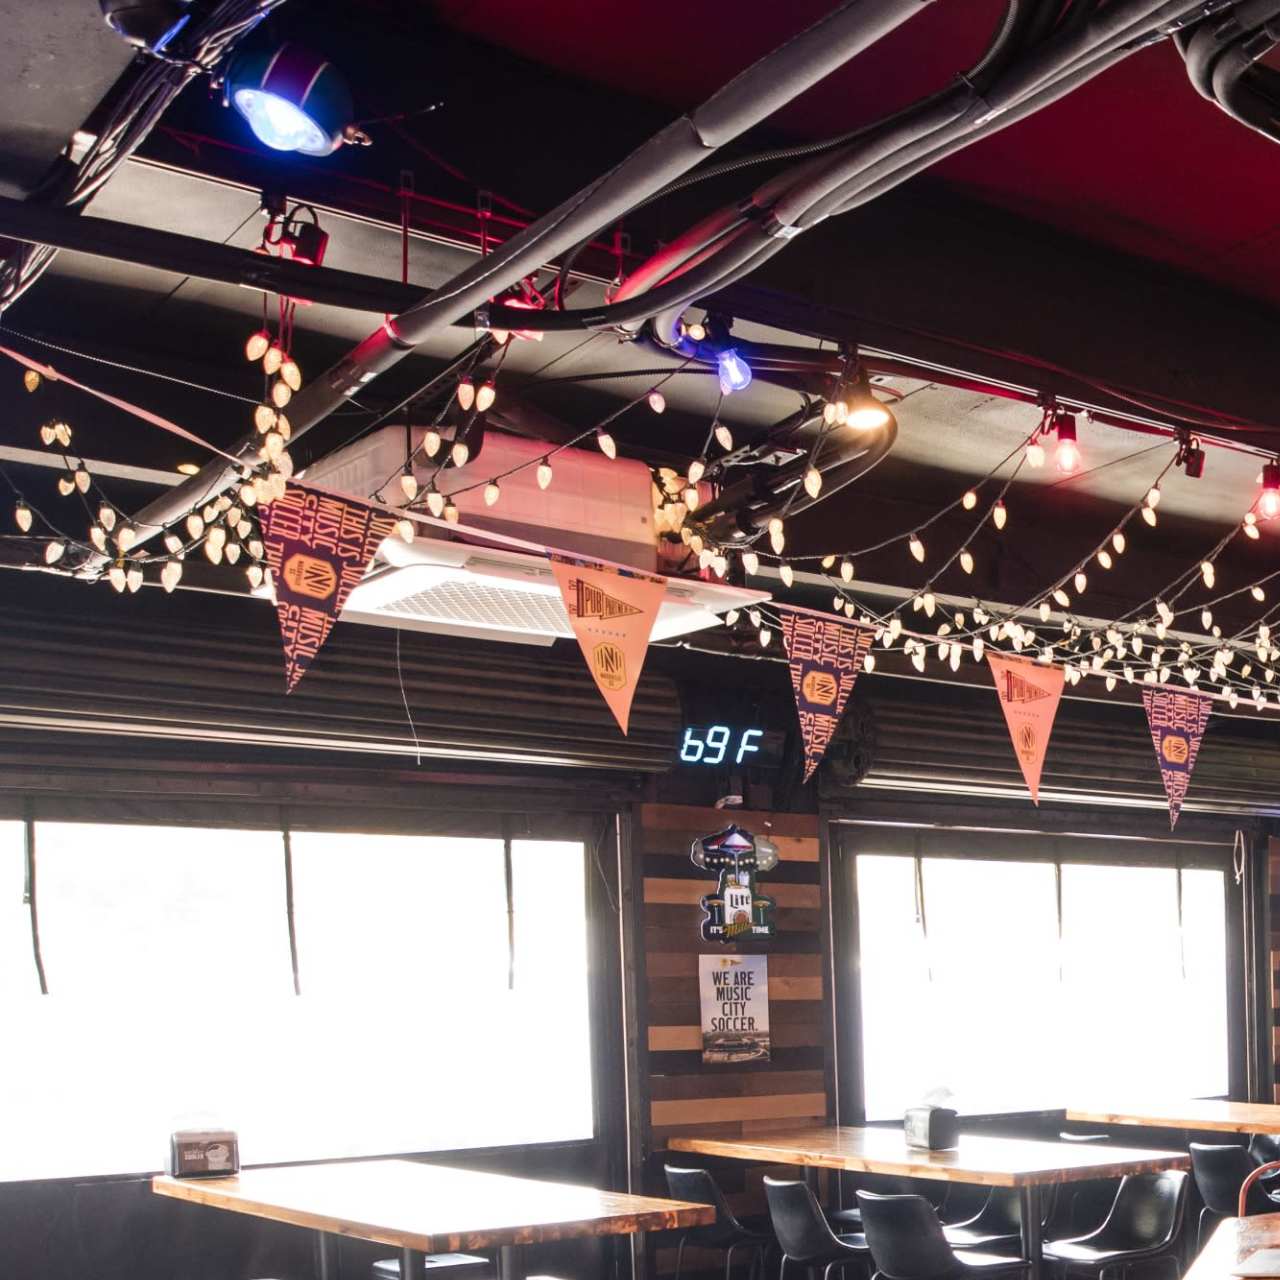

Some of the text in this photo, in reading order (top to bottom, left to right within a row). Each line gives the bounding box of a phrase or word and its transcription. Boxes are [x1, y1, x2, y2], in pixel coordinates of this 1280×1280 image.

[301, 494, 318, 549] CITY
[313, 496, 342, 554] MUSIC
[341, 505, 369, 543] THIS
[296, 607, 328, 659] MUSIC
[821, 622, 840, 668] MUSIC
[736, 729, 763, 764] F
[729, 893, 751, 908] Lite
[752, 926, 769, 935] TIME
[712, 971, 754, 986] WE ARE
[716, 986, 751, 1001] MUSIC
[722, 1002, 746, 1017] CITY
[711, 1017, 758, 1032] SOCCER.
